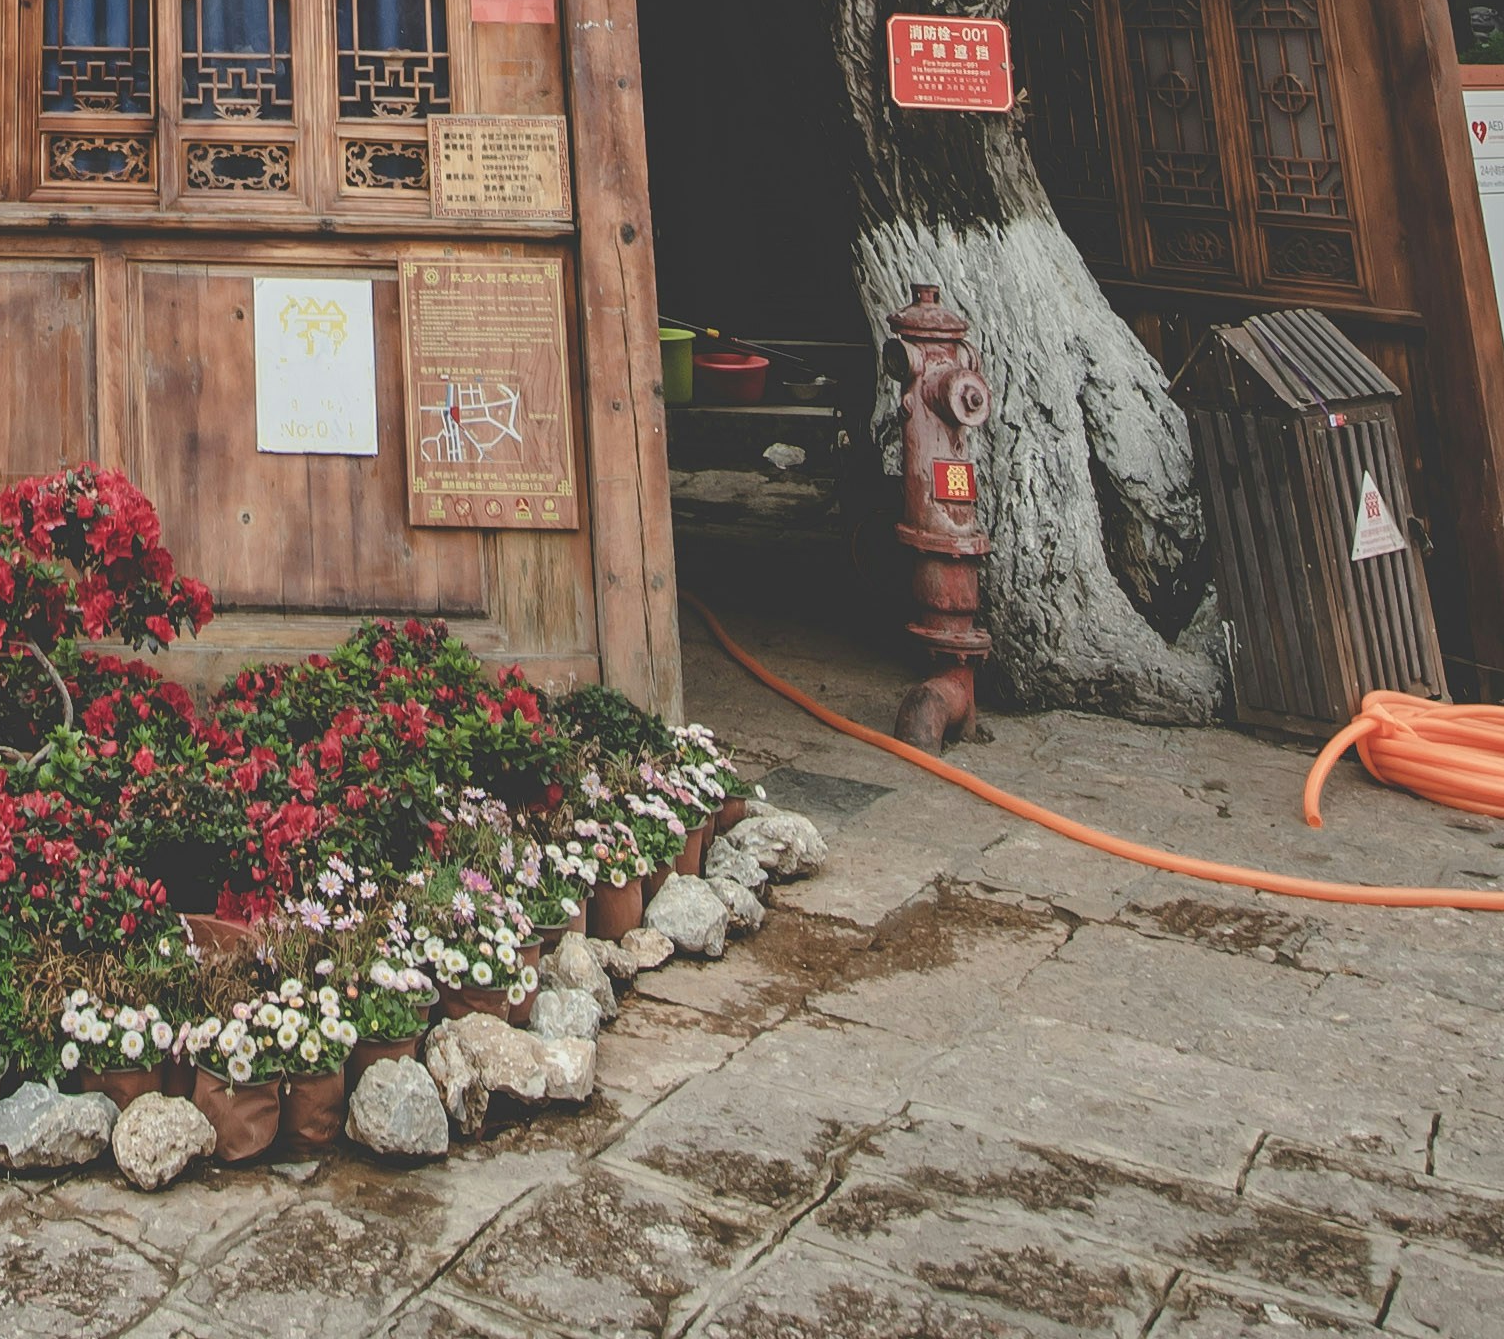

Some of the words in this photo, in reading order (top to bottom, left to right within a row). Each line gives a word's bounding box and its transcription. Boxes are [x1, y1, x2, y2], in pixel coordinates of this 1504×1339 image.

[909, 24, 989, 42] 消防栓-001
[910, 41, 990, 61] 严禁遮挡
[1488, 120, 1504, 131] AED
